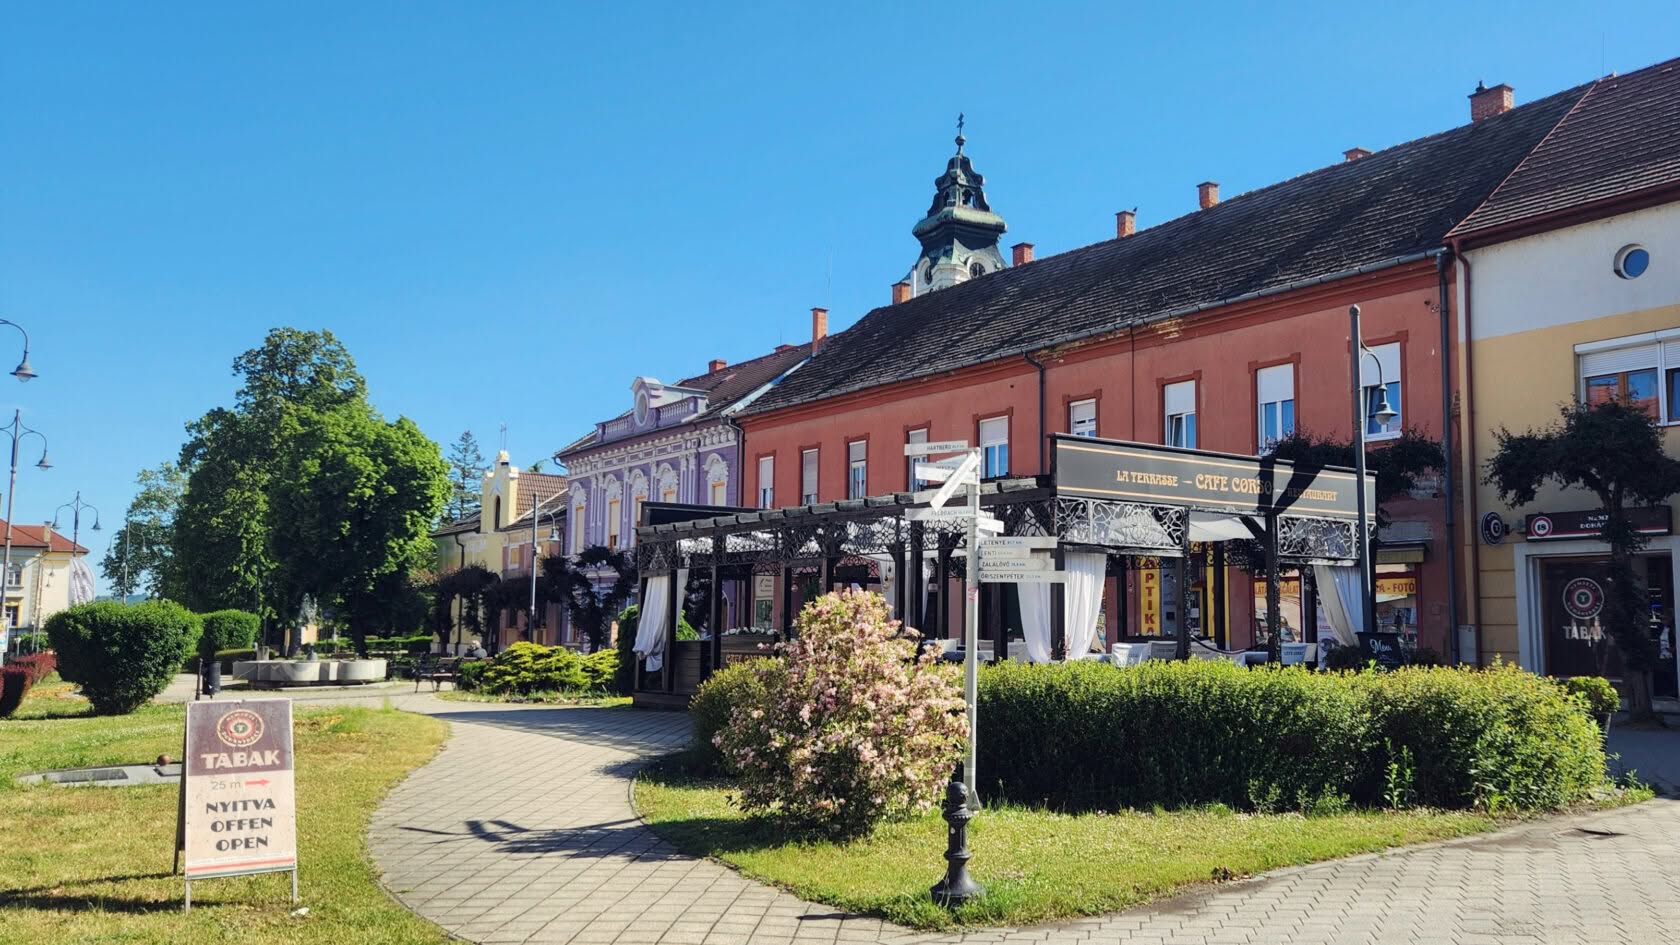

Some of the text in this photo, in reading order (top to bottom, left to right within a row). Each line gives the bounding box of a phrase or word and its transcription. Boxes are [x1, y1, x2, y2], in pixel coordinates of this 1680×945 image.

[1116, 469, 1129, 482] LA
[1130, 471, 1179, 487] TERRASSE
[1195, 473, 1229, 492] CAFE
[1231, 477, 1273, 495] CORSO
[1562, 625, 1607, 640] TABAK
[200, 749, 281, 769] TABAK
[210, 780, 241, 791] 25 m
[206, 798, 276, 815] NYITVA
[210, 817, 273, 833] OFFEN
[215, 835, 269, 852] OPEN
